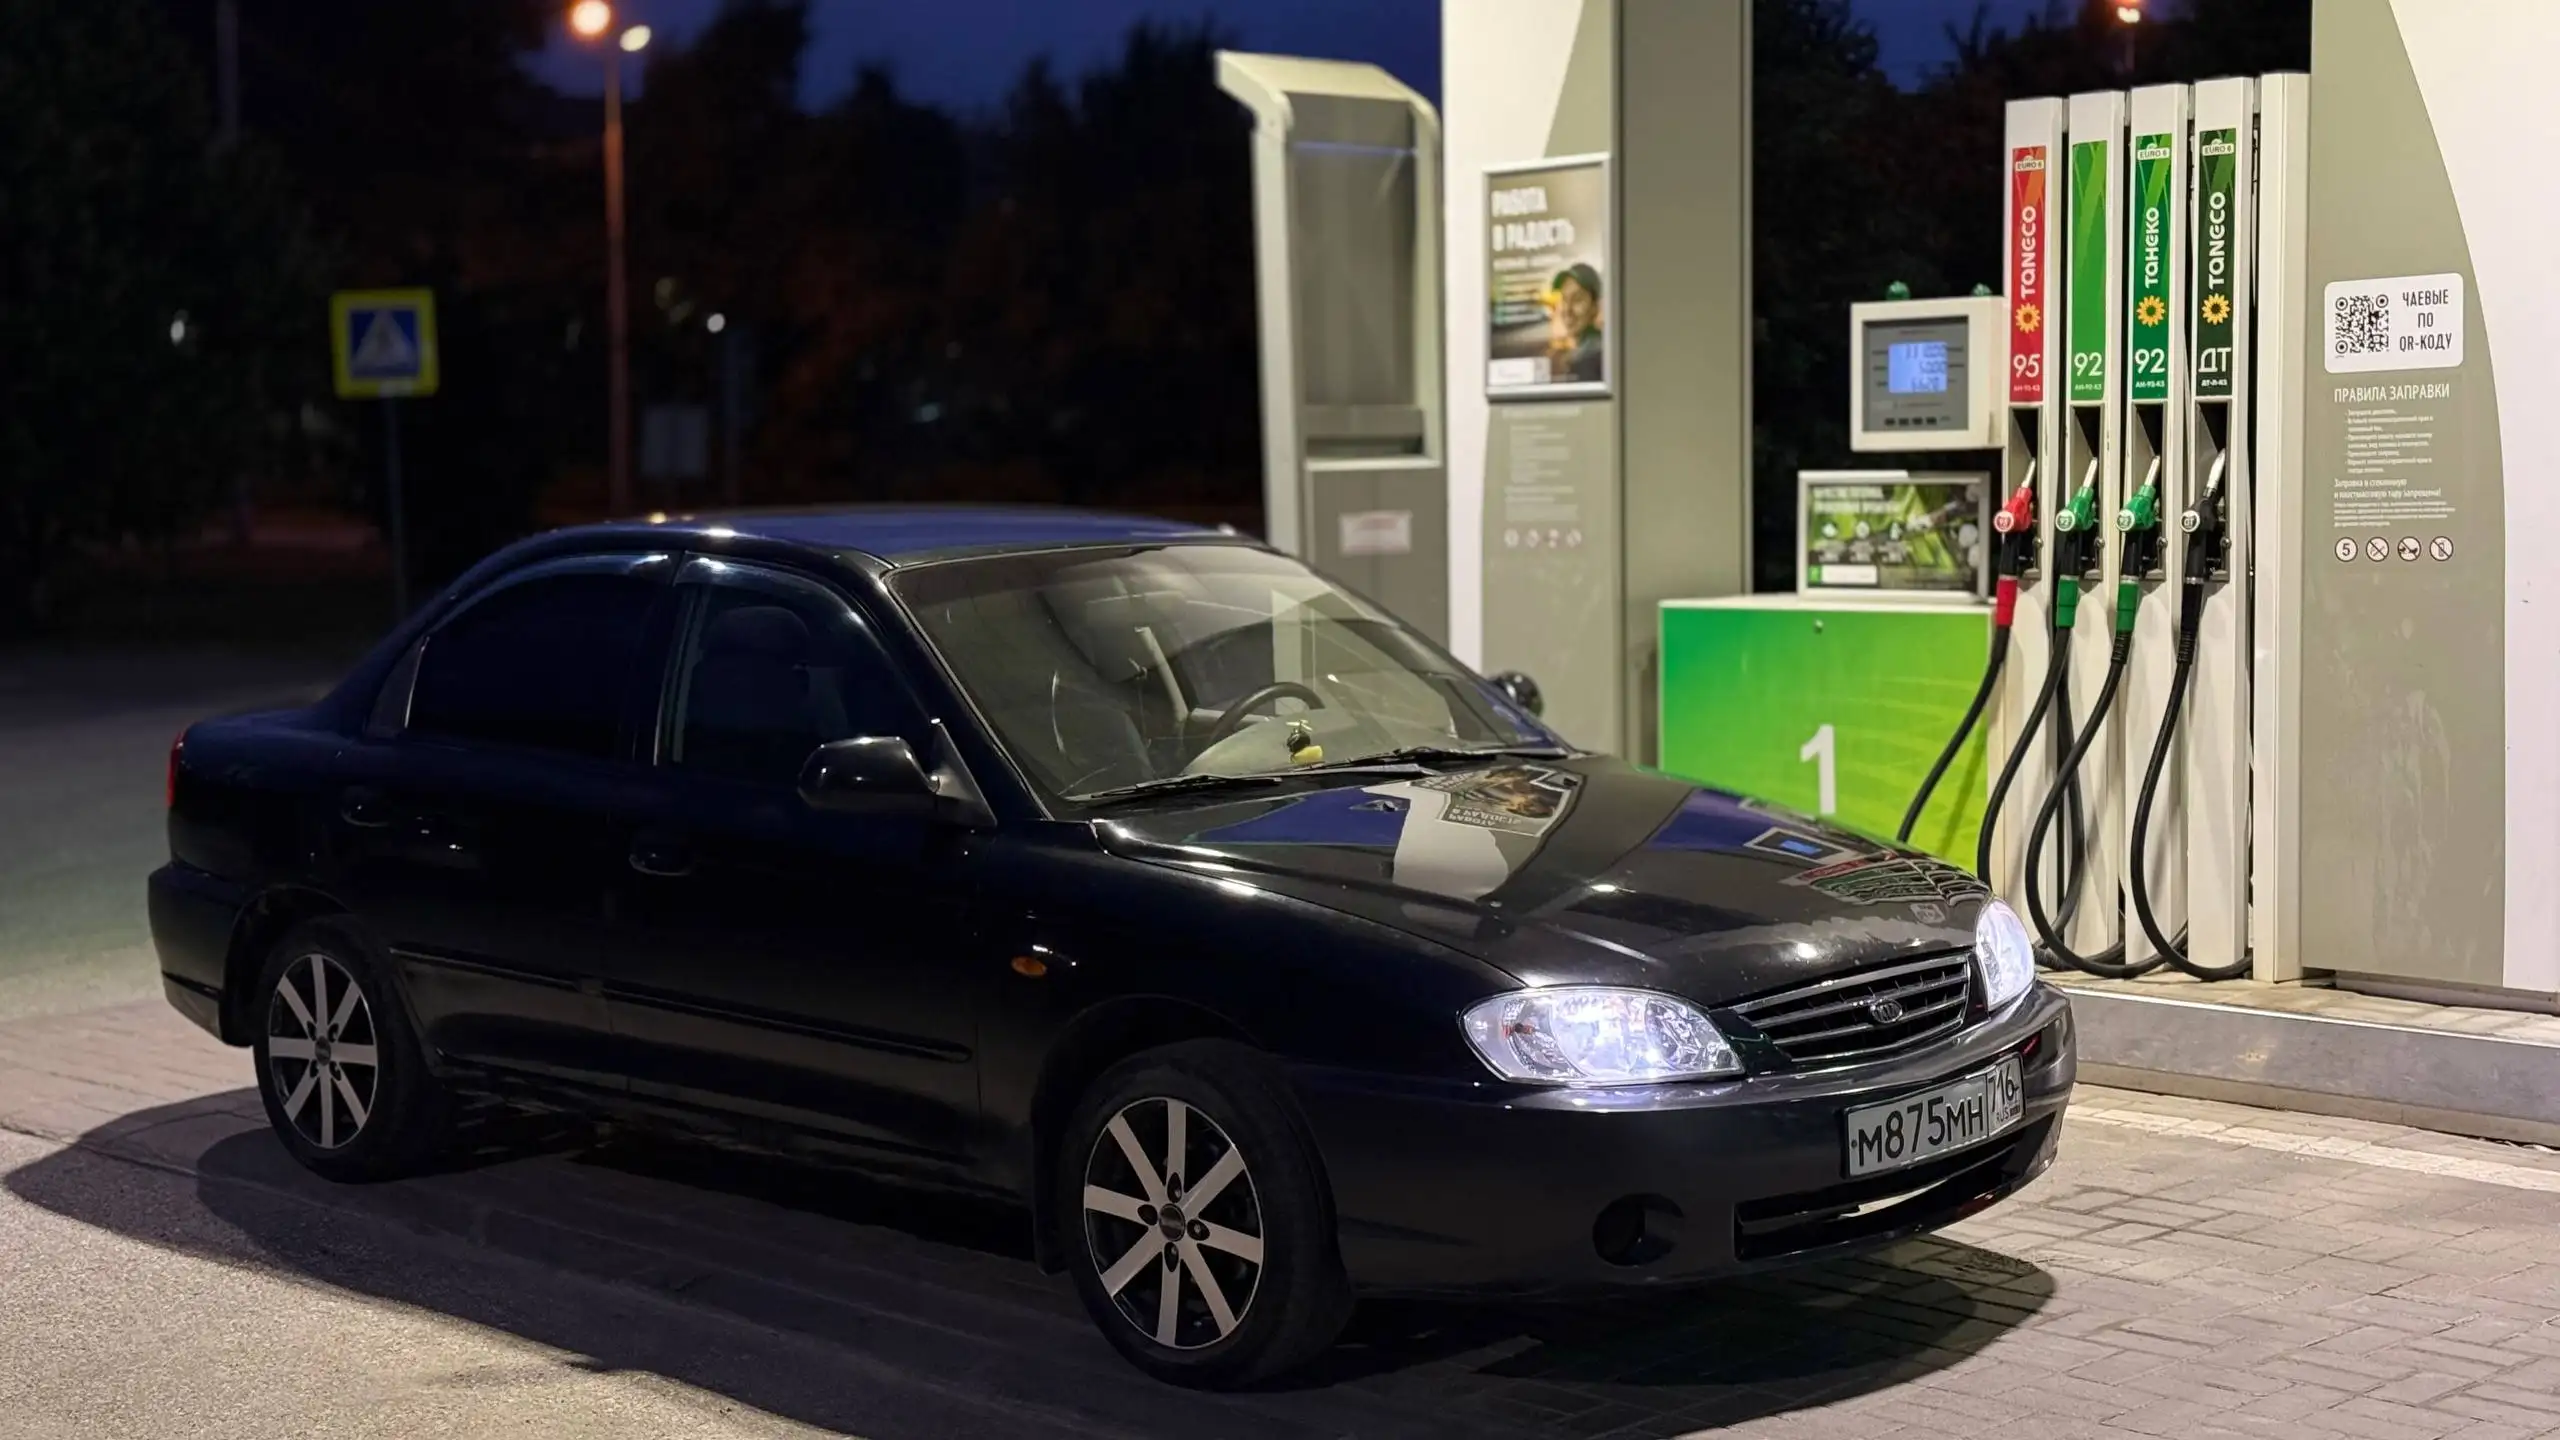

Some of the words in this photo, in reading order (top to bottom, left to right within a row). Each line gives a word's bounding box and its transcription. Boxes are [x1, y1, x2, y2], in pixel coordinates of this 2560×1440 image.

[2140, 150, 2160, 158] EURO
[2205, 145, 2225, 154] EURO
[2021, 206, 2037, 299] TANECO
[2145, 207, 2159, 288] ТАНЕКО
[2208, 191, 2226, 289] TANECO
[2402, 289, 2449, 307] ЧАЕВЫЕ
[2418, 312, 2434, 328] ПО
[2399, 333, 2452, 353] QR-КОДУ
[2013, 353, 2041, 378] 95
[2074, 352, 2103, 377] 92
[2135, 348, 2166, 374] 92
[2198, 347, 2232, 372] ДТ
[2334, 386, 2387, 404] ПРАВИЛА
[2390, 383, 2450, 401] ЗАПРАВКИ
[2341, 542, 2351, 556] 5
[1801, 724, 1835, 814] 1
[1858, 1094, 1984, 1166] М875МН
[1988, 1063, 2015, 1112] 716
